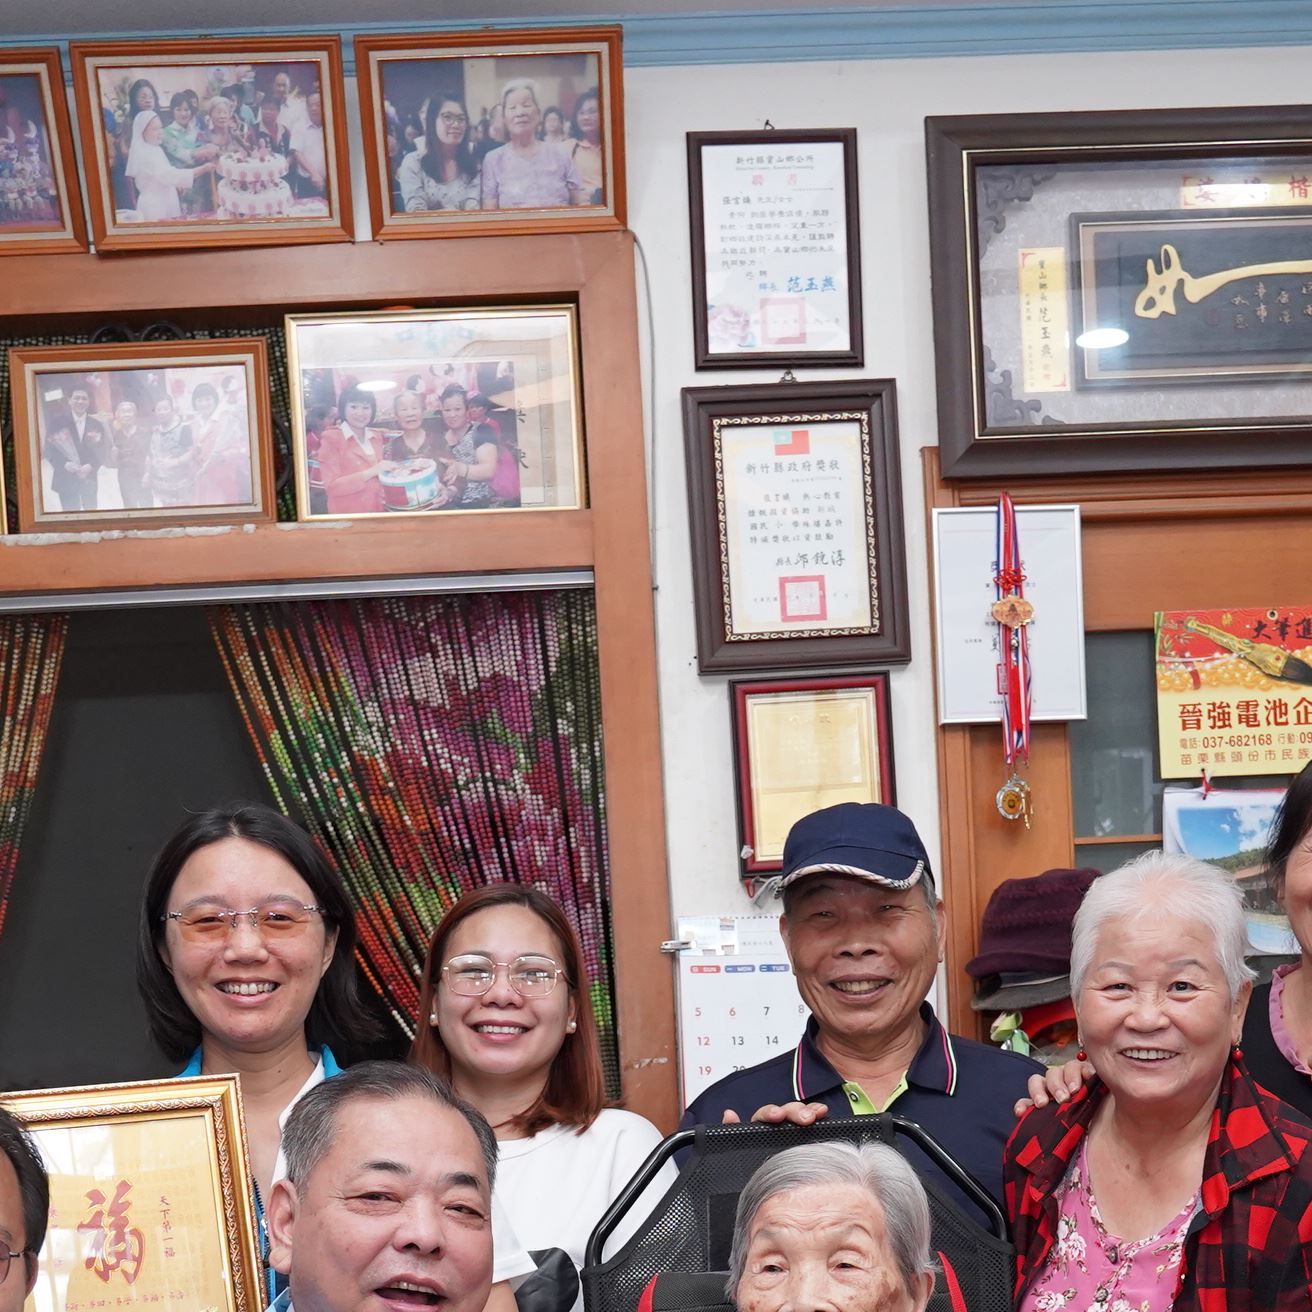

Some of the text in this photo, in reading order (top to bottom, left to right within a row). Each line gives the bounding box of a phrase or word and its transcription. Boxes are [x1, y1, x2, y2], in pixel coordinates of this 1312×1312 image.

[1202, 733, 1273, 749] 037-682168
[695, 1007, 701, 1016] 5
[729, 1007, 736, 1016] 6
[763, 1007, 770, 1016] 7
[798, 1005, 805, 1013] 8
[697, 1036, 710, 1046] 12
[731, 1036, 744, 1045] 13
[766, 1035, 778, 1045] 14
[699, 1066, 712, 1076] 19
[159, 1195, 176, 1258] 天下第一福
